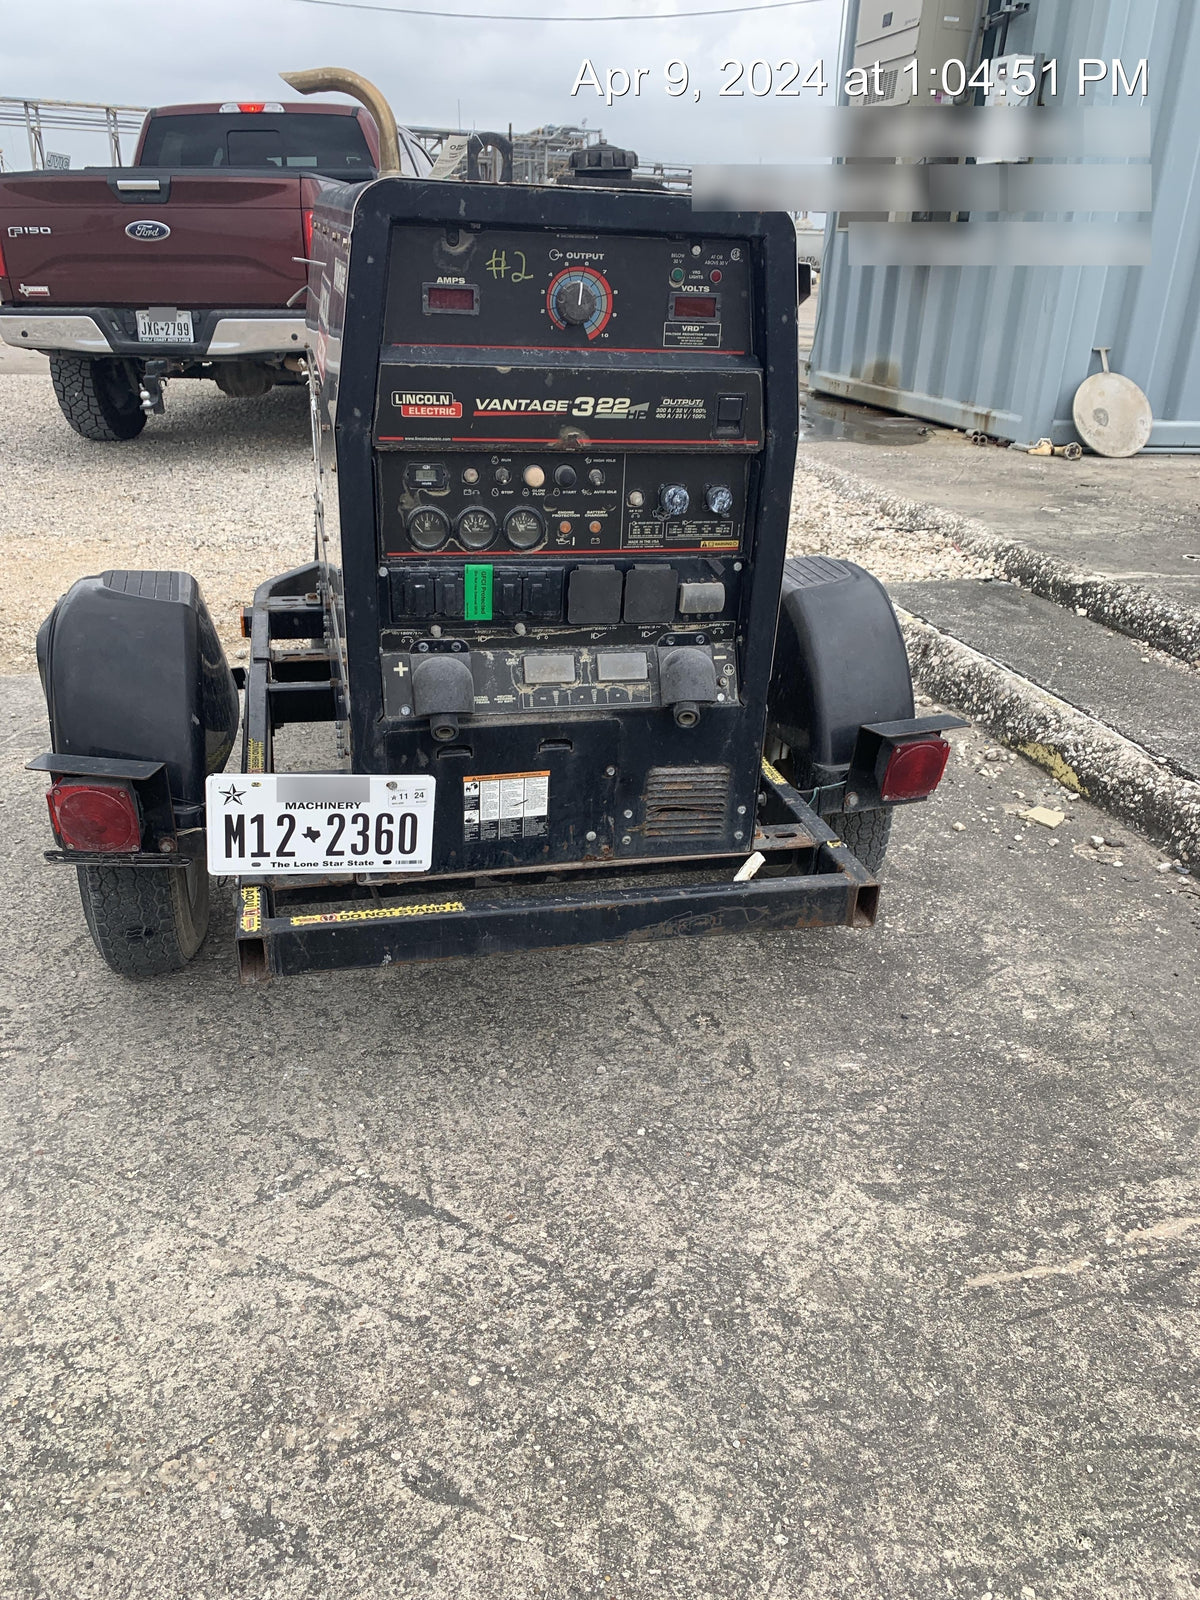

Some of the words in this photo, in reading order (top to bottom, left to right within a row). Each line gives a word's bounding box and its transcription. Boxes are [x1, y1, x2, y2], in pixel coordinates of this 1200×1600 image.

[8, 226, 51, 237] F150
[136, 224, 159, 237] Ford
[566, 252, 605, 260] OUTPUT
[485, 249, 534, 283] #2
[437, 276, 465, 284] AMPS
[141, 321, 160, 335] JXG
[165, 322, 190, 336] 2799
[395, 394, 450, 405] LINCOLN
[409, 407, 457, 416] ELECTRIC
[475, 398, 569, 412] VANTAGE
[572, 396, 631, 416] 322
[285, 801, 362, 810] MACHINERY
[224, 813, 296, 858] M12
[326, 812, 418, 857] 2360
[348, 859, 374, 867] State
[340, 912, 362, 920] DO
[400, 905, 446, 914] STAND
